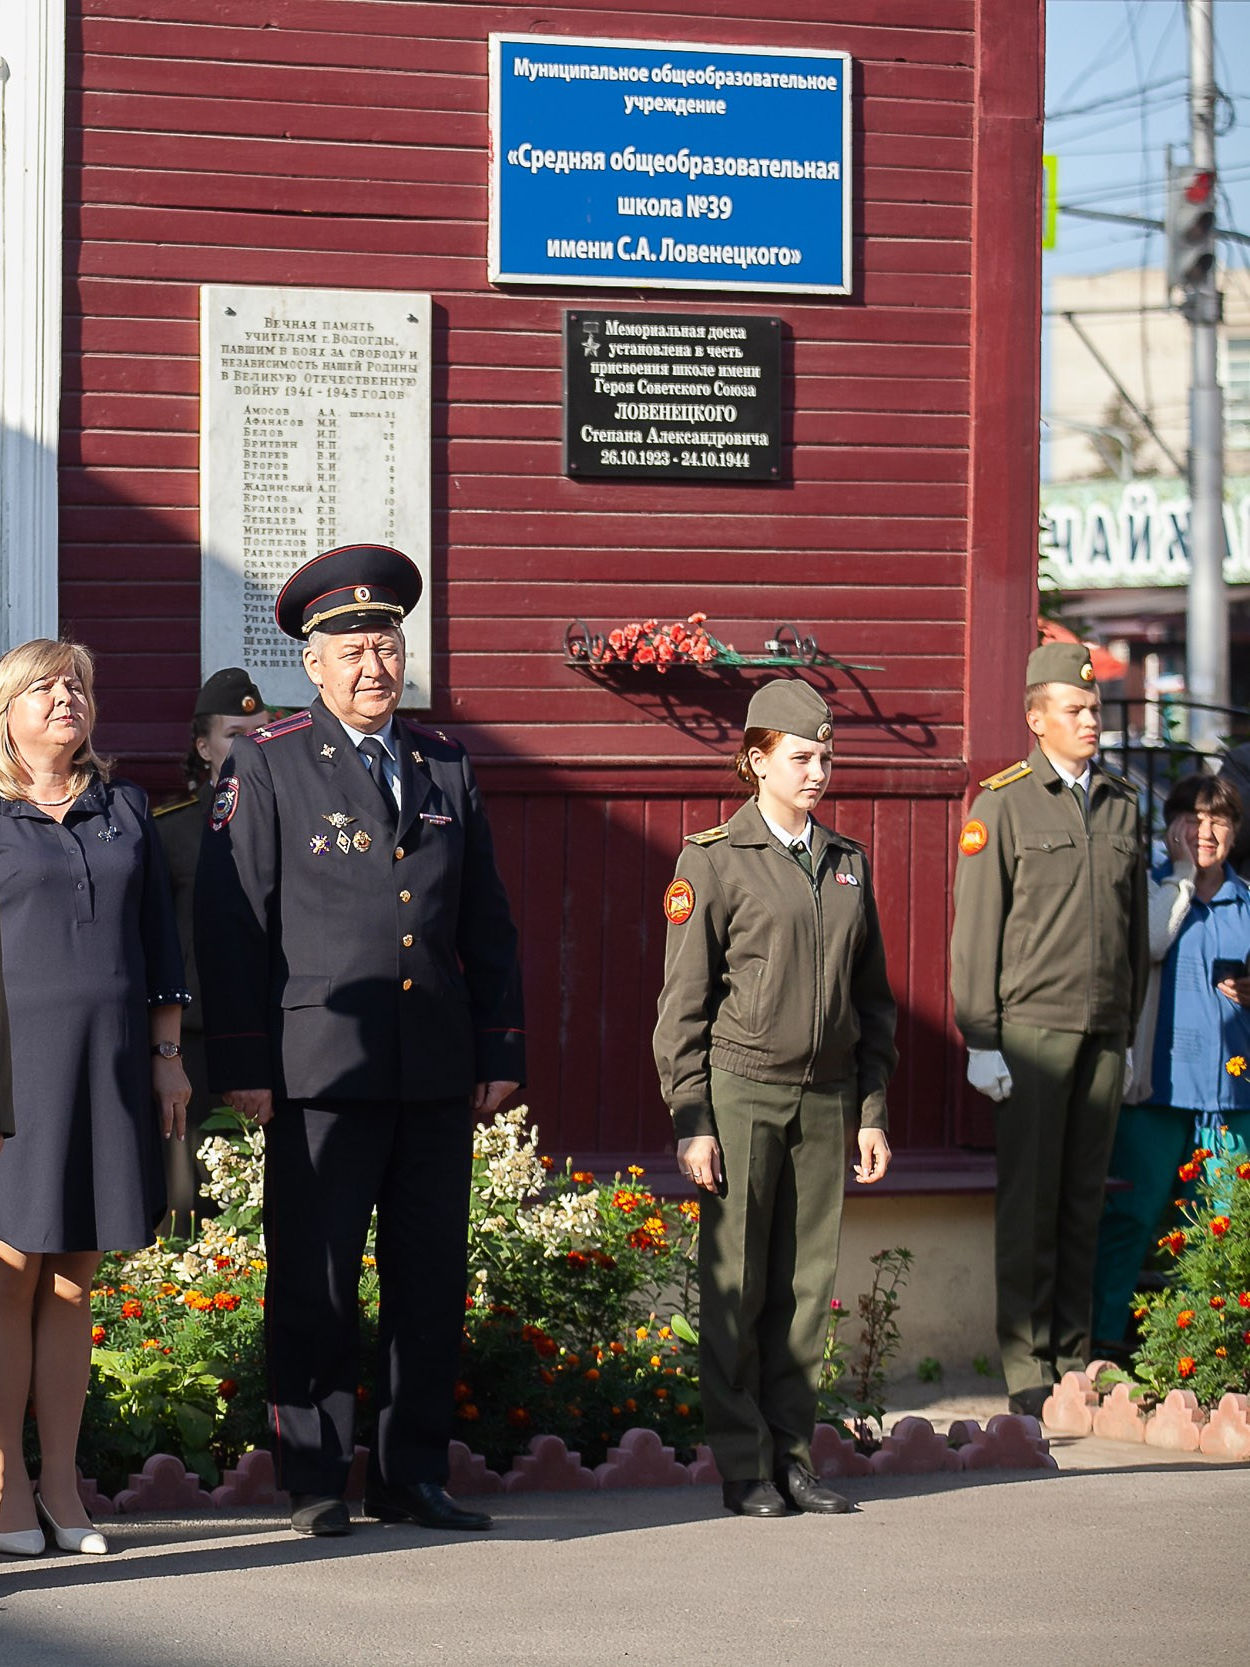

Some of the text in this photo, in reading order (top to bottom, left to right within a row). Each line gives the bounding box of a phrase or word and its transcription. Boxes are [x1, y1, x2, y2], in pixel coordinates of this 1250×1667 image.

[513, 57, 838, 91] Муниципальное общеобразовательное
[624, 94, 727, 115] учреждение
[507, 142, 841, 180] «Средняя общеобразовательная
[617, 194, 733, 220] школа №39
[547, 236, 802, 269] имени С.А. Ловенецкого»
[605, 320, 747, 341] Мемориальная доска
[608, 342, 743, 359] установлена в честь
[590, 361, 761, 378] присвоения школе имени
[285, 386, 313, 398] 1941
[327, 388, 358, 398] 1945
[594, 378, 757, 397] Героя Советского Союза
[614, 402, 737, 424] ЛОВЕНЕЦКОГО
[580, 424, 769, 448] Степана Александровича
[600, 449, 671, 466] 26.10.1923
[681, 450, 750, 468] 24.10.1944
